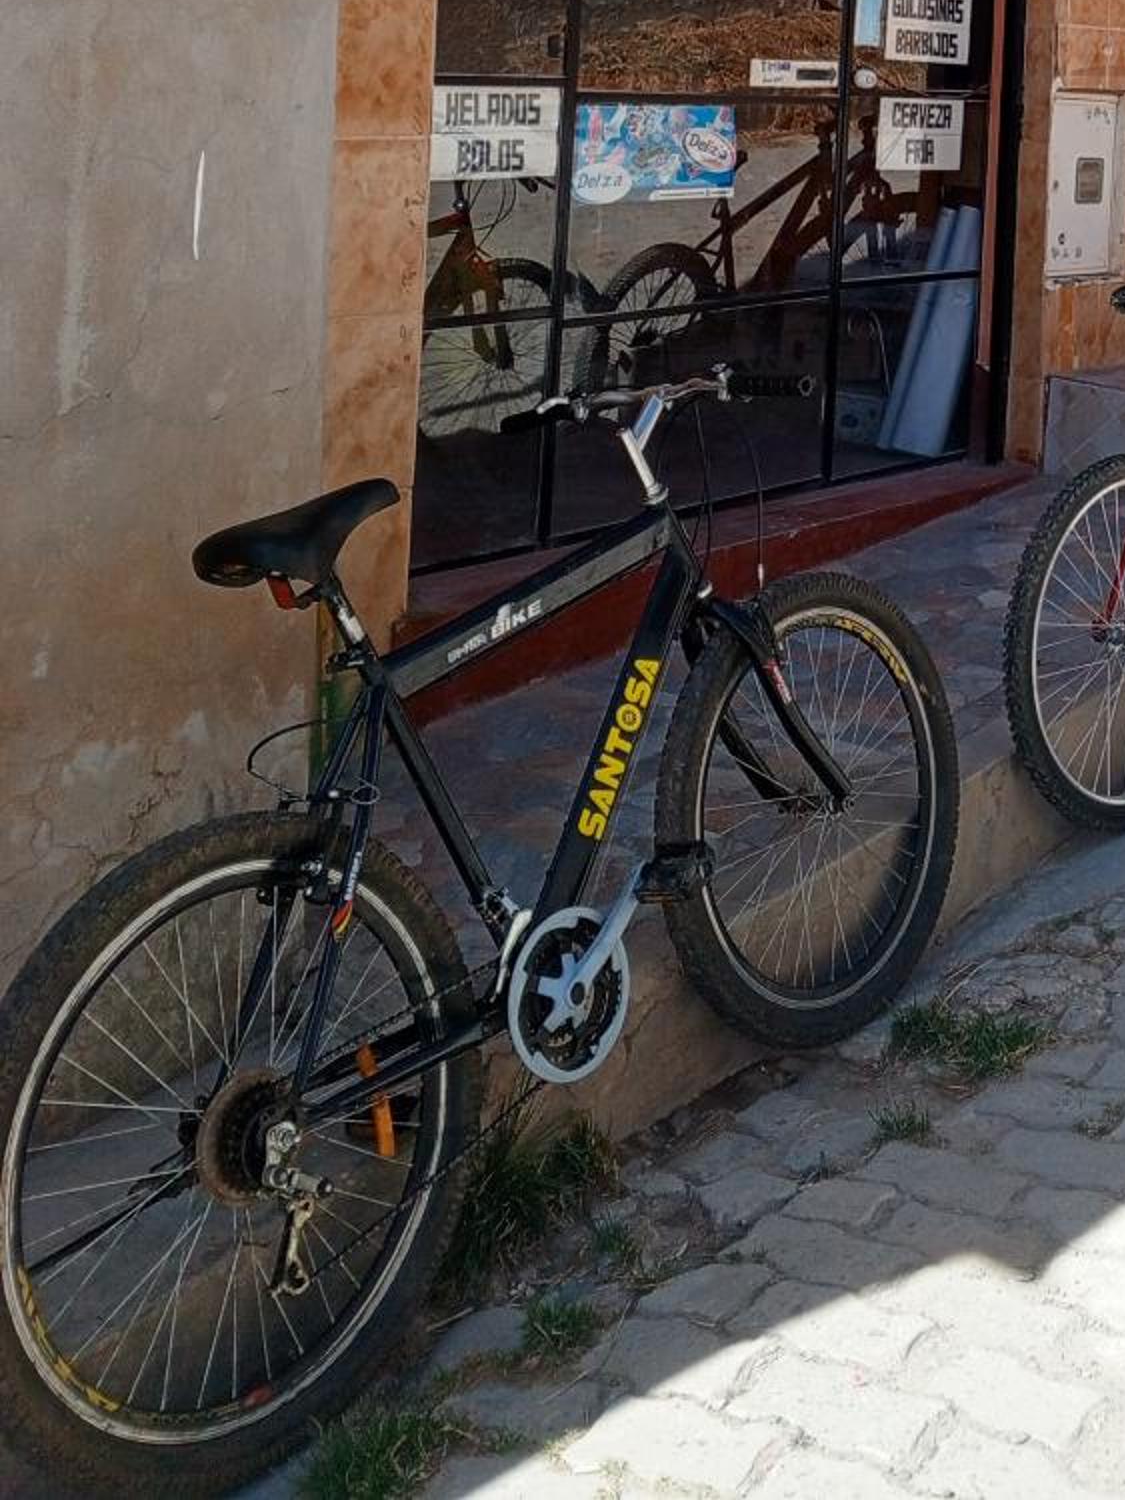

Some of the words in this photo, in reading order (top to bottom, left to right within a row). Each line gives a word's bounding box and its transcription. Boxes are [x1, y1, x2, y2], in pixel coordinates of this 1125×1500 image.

[895, 28, 959, 58] BARBIJOS
[445, 93, 541, 128] HELADOS
[892, 102, 952, 129] CERVEZA
[457, 139, 525, 174] BOLOS
[577, 658, 660, 841] SANTOSA
